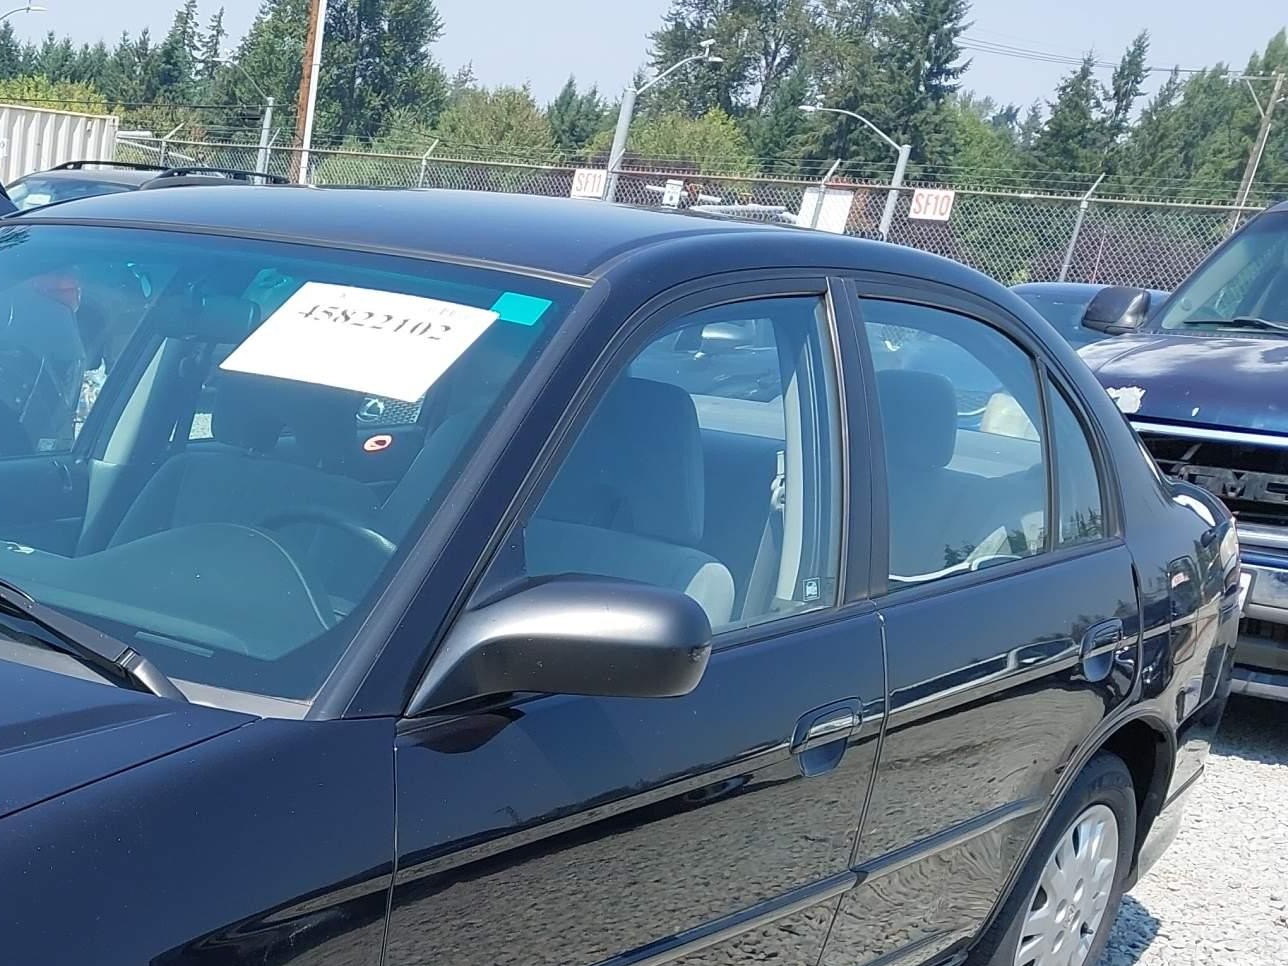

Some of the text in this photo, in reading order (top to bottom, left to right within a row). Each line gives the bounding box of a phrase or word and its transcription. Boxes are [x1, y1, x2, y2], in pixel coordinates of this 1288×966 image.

[576, 172, 602, 193] SF11
[912, 192, 951, 216] SF10
[298, 304, 452, 341] 45822102
